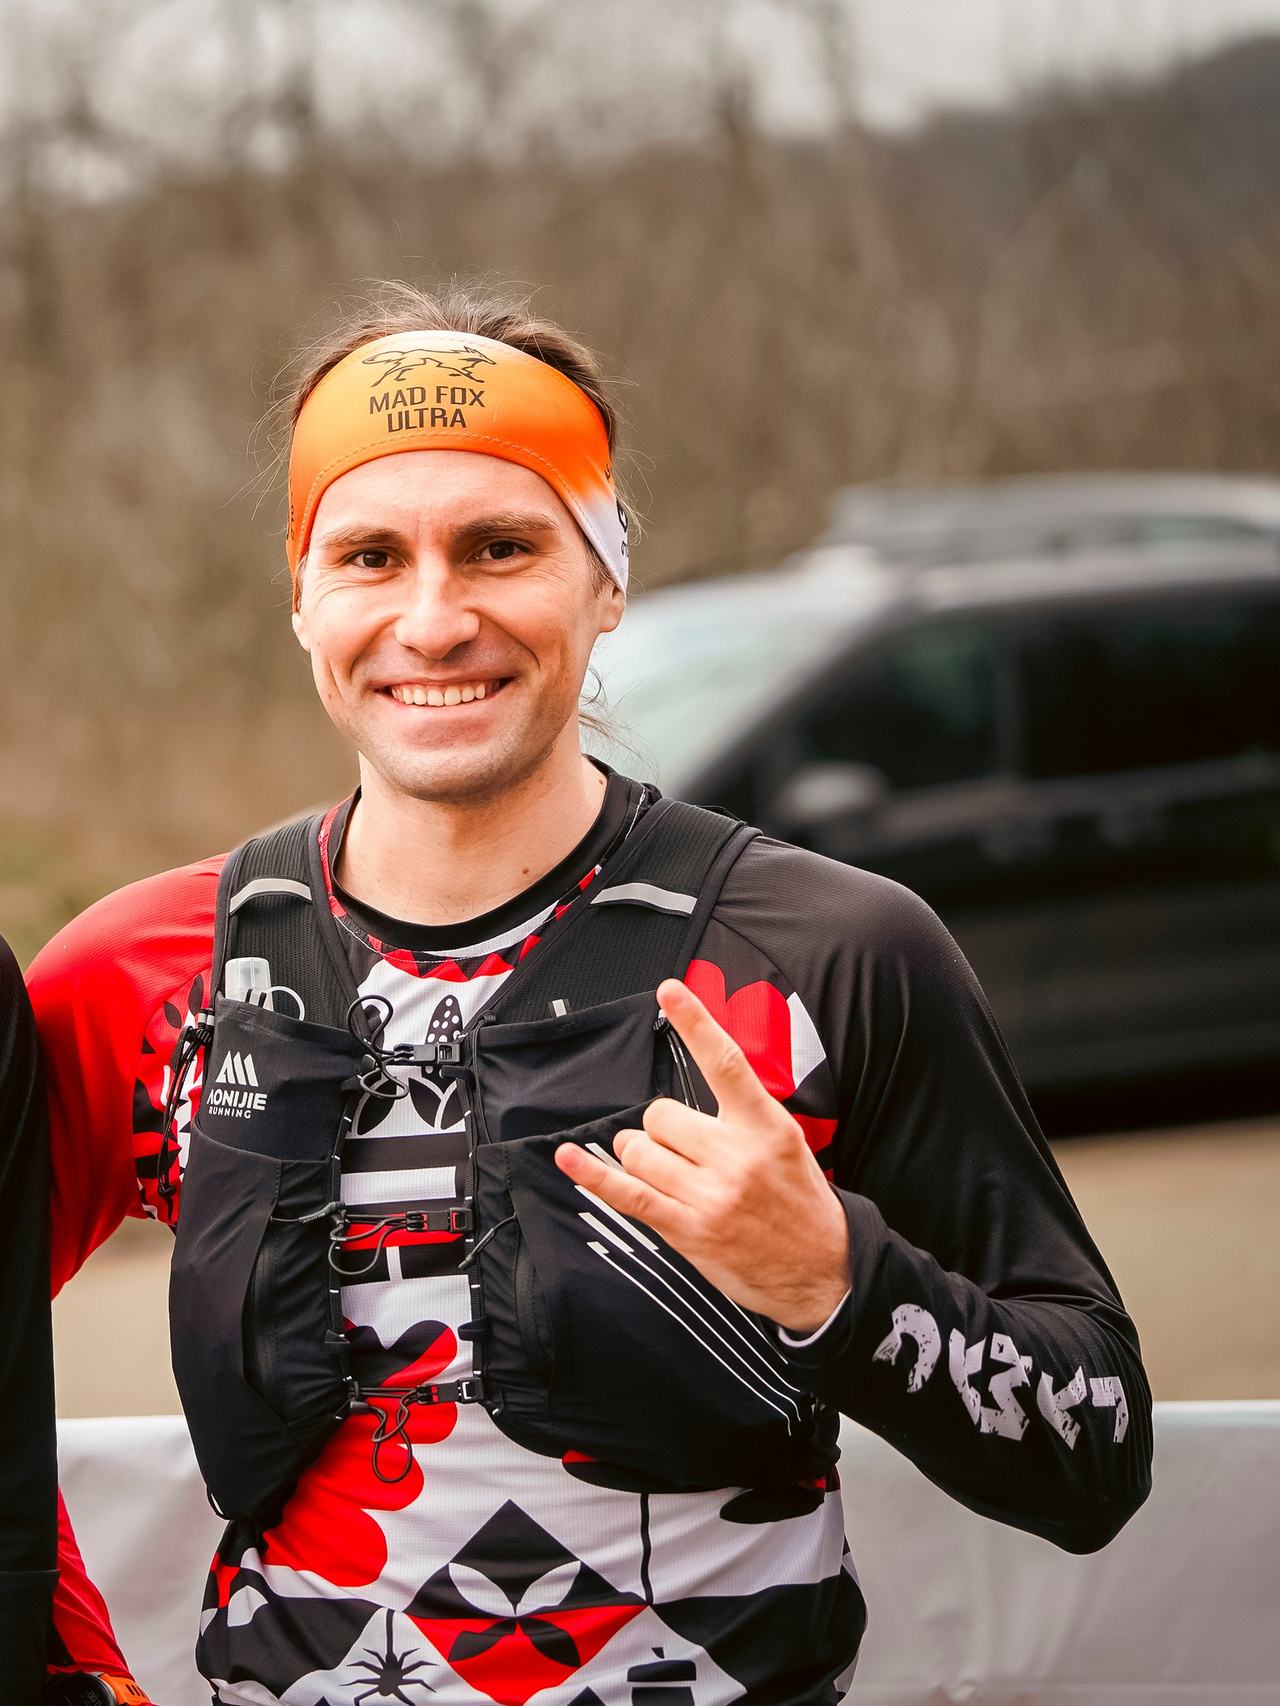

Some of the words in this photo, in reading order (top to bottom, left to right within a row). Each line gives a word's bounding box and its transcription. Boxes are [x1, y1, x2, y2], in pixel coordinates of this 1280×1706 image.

[369, 386, 427, 415] MAD
[436, 385, 486, 408] FOX
[387, 407, 467, 433] ULTRA
[206, 1088, 268, 1111] AONIJIE
[208, 1106, 252, 1119] RUNNING
